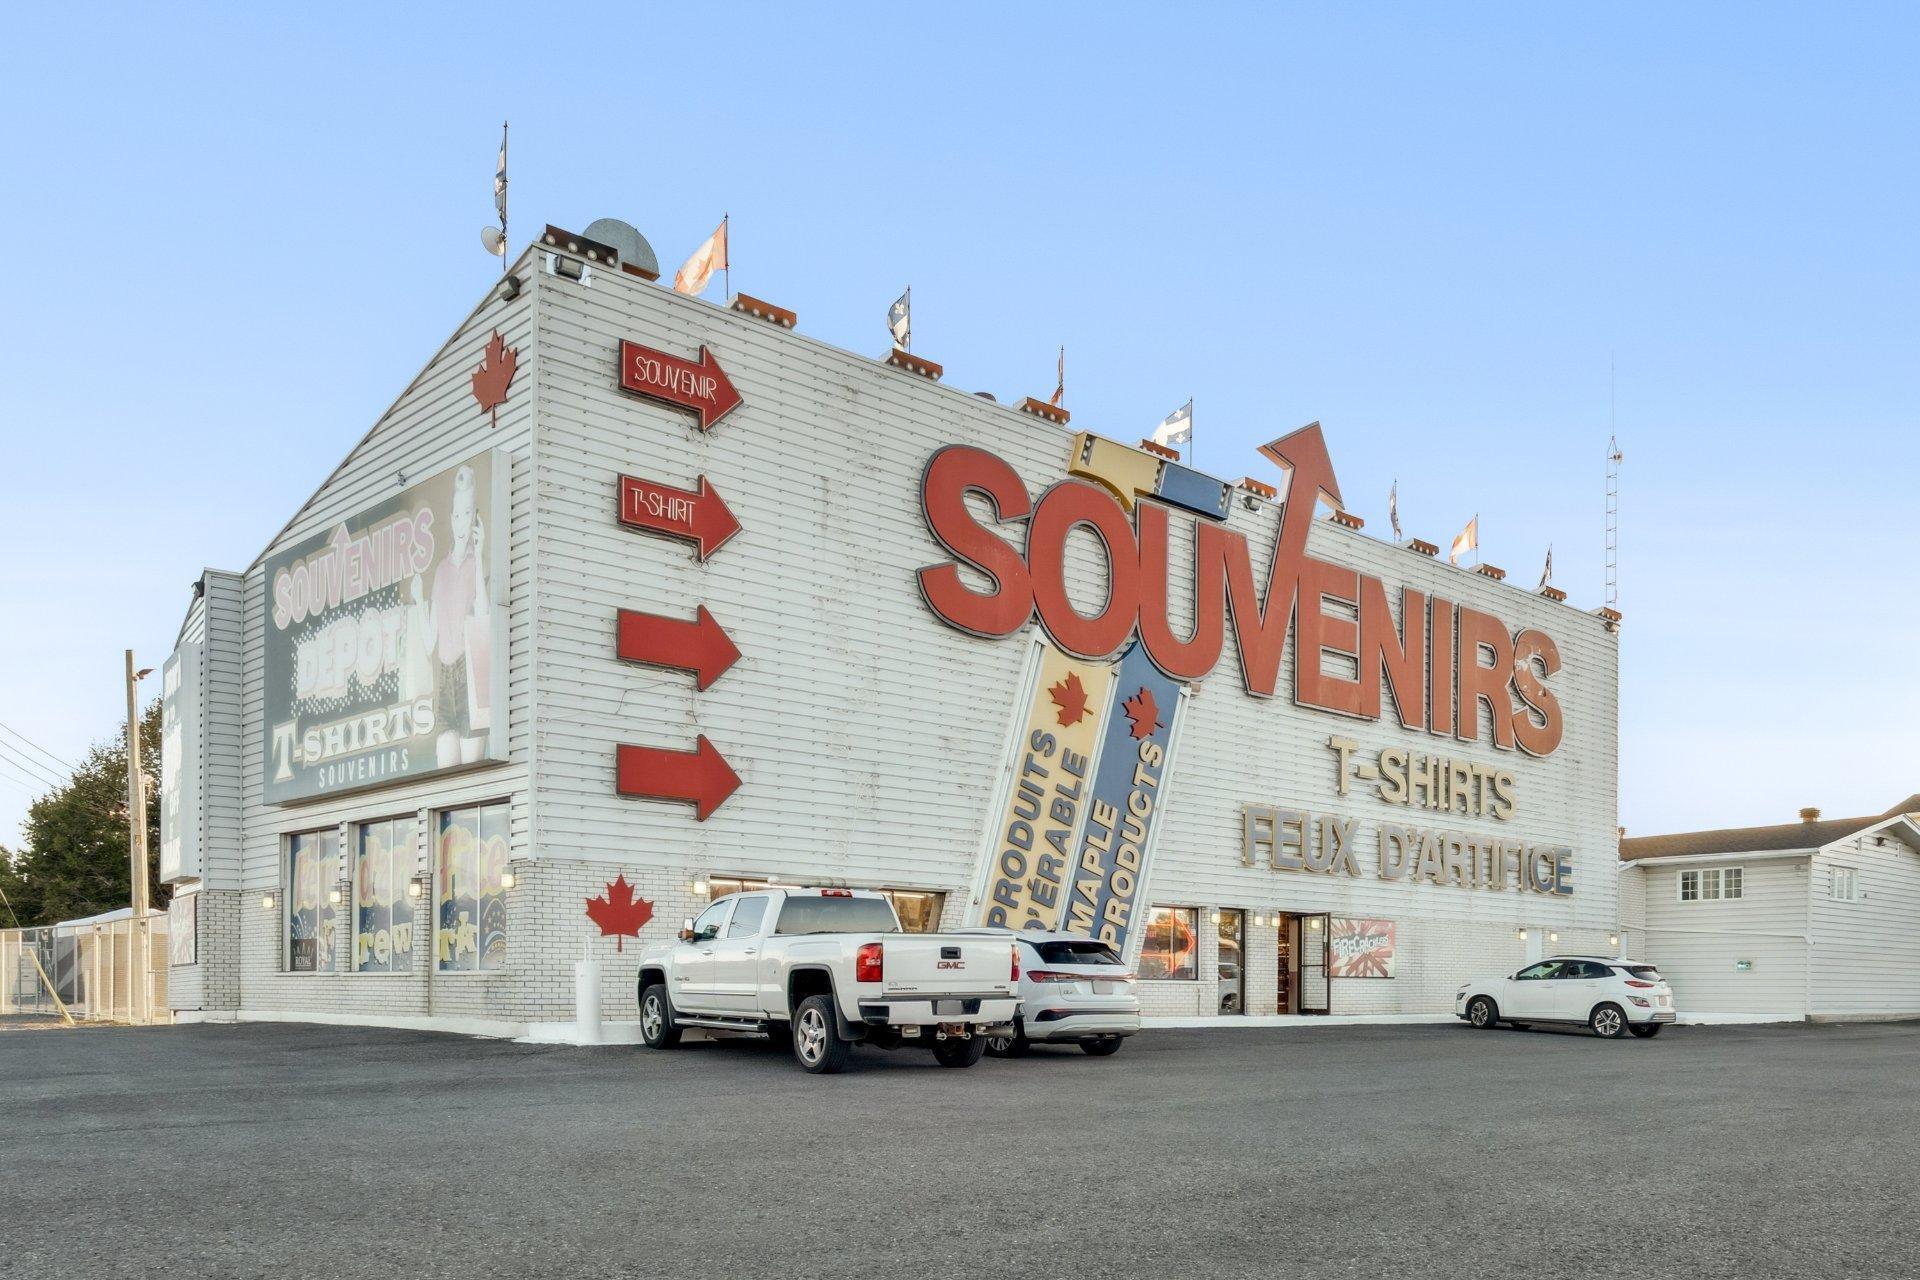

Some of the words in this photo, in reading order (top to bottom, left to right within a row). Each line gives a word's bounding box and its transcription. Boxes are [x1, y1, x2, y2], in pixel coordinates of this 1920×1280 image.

[634, 355, 717, 405] SOUVENIR
[630, 487, 696, 528] T-SHIRT
[273, 506, 435, 631] SOUVENIRS
[918, 420, 1564, 758] SOUVENIRS
[272, 696, 436, 782] T-SHIRTS
[318, 747, 409, 789] SOUVENIRS
[1328, 735, 1518, 820] T-SHIRTS
[987, 728, 1056, 929] PRODUITS
[1065, 798, 1118, 938] MAPLE
[1098, 740, 1163, 953] PRODUCTS
[1242, 803, 1363, 877] FEUX
[1377, 823, 1574, 895] D'ARTIFICE
[936, 961, 966, 970] GMC
